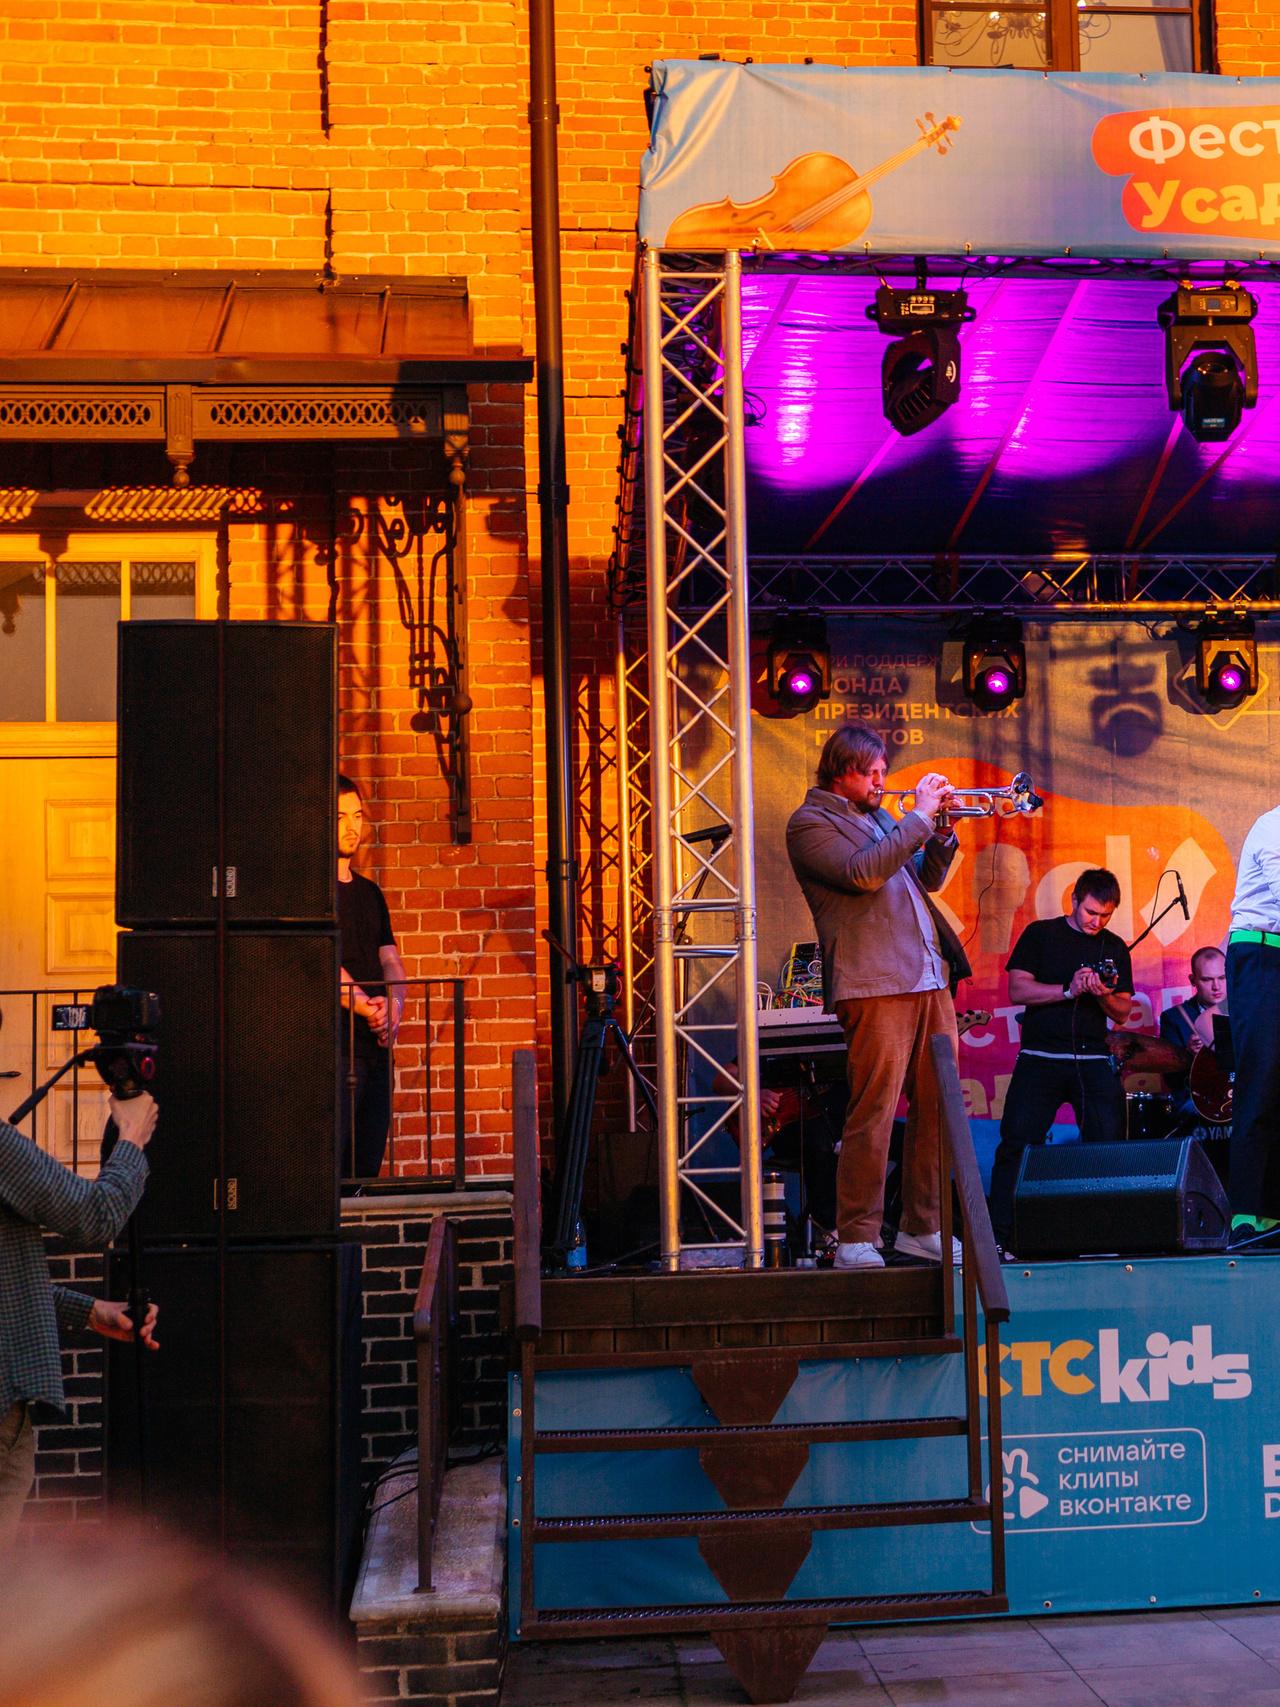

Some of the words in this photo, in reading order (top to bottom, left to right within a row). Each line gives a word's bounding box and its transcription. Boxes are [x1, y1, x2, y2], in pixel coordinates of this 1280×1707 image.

[830, 676, 904, 696] ОНДА
[1058, 1438, 1186, 1464] снимайте
[1059, 1470, 1139, 1490] клипы
[1060, 1493, 1192, 1516] вконтакте
